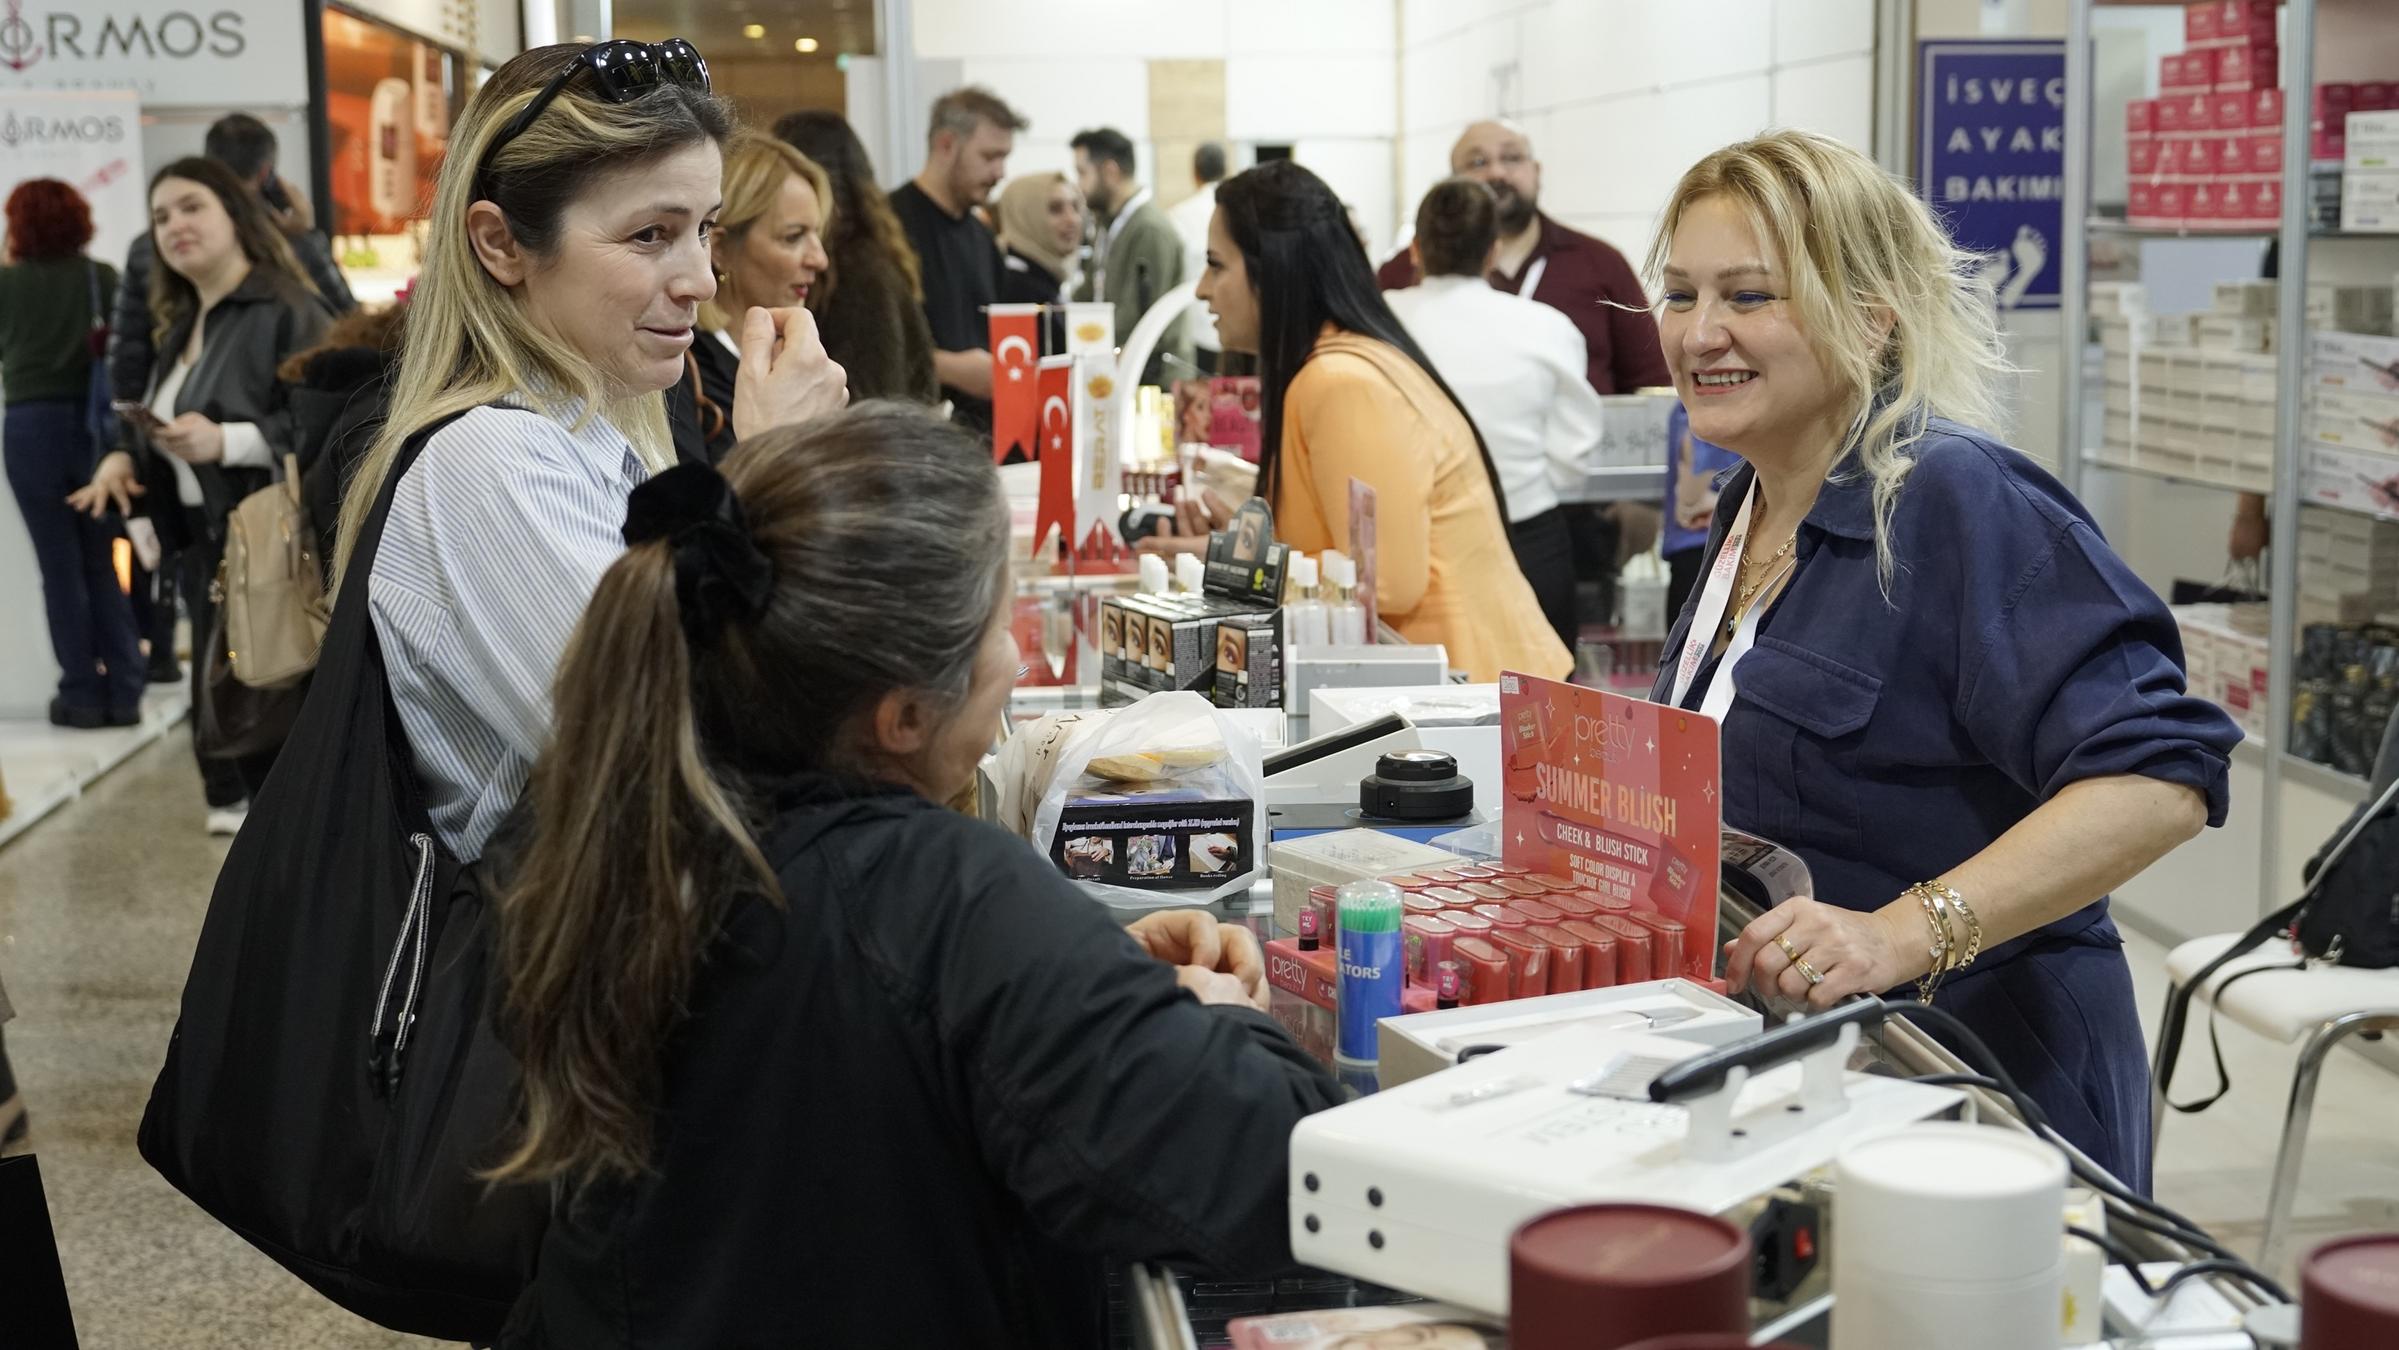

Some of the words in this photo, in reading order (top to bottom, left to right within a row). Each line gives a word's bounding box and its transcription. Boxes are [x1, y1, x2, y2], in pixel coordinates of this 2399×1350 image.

[1947, 73, 2064, 109] İSVEÇ
[1947, 126, 2063, 154] AYAK
[1574, 713, 1636, 760] pretty
[1536, 761, 1613, 816] SUMMER
[1618, 784, 1677, 838] BLUSH
[1556, 823, 1584, 846] CHEEK
[1585, 831, 1591, 848] &
[1595, 835, 1622, 858] BLUSH
[1623, 844, 1649, 866] STICK
[1569, 854, 1584, 870] SOFT
[1584, 858, 1605, 876] COLOR
[1605, 863, 1631, 889] DISPLAY
[1612, 884, 1632, 901] BLUSH
[1271, 955, 1307, 991] pretty
